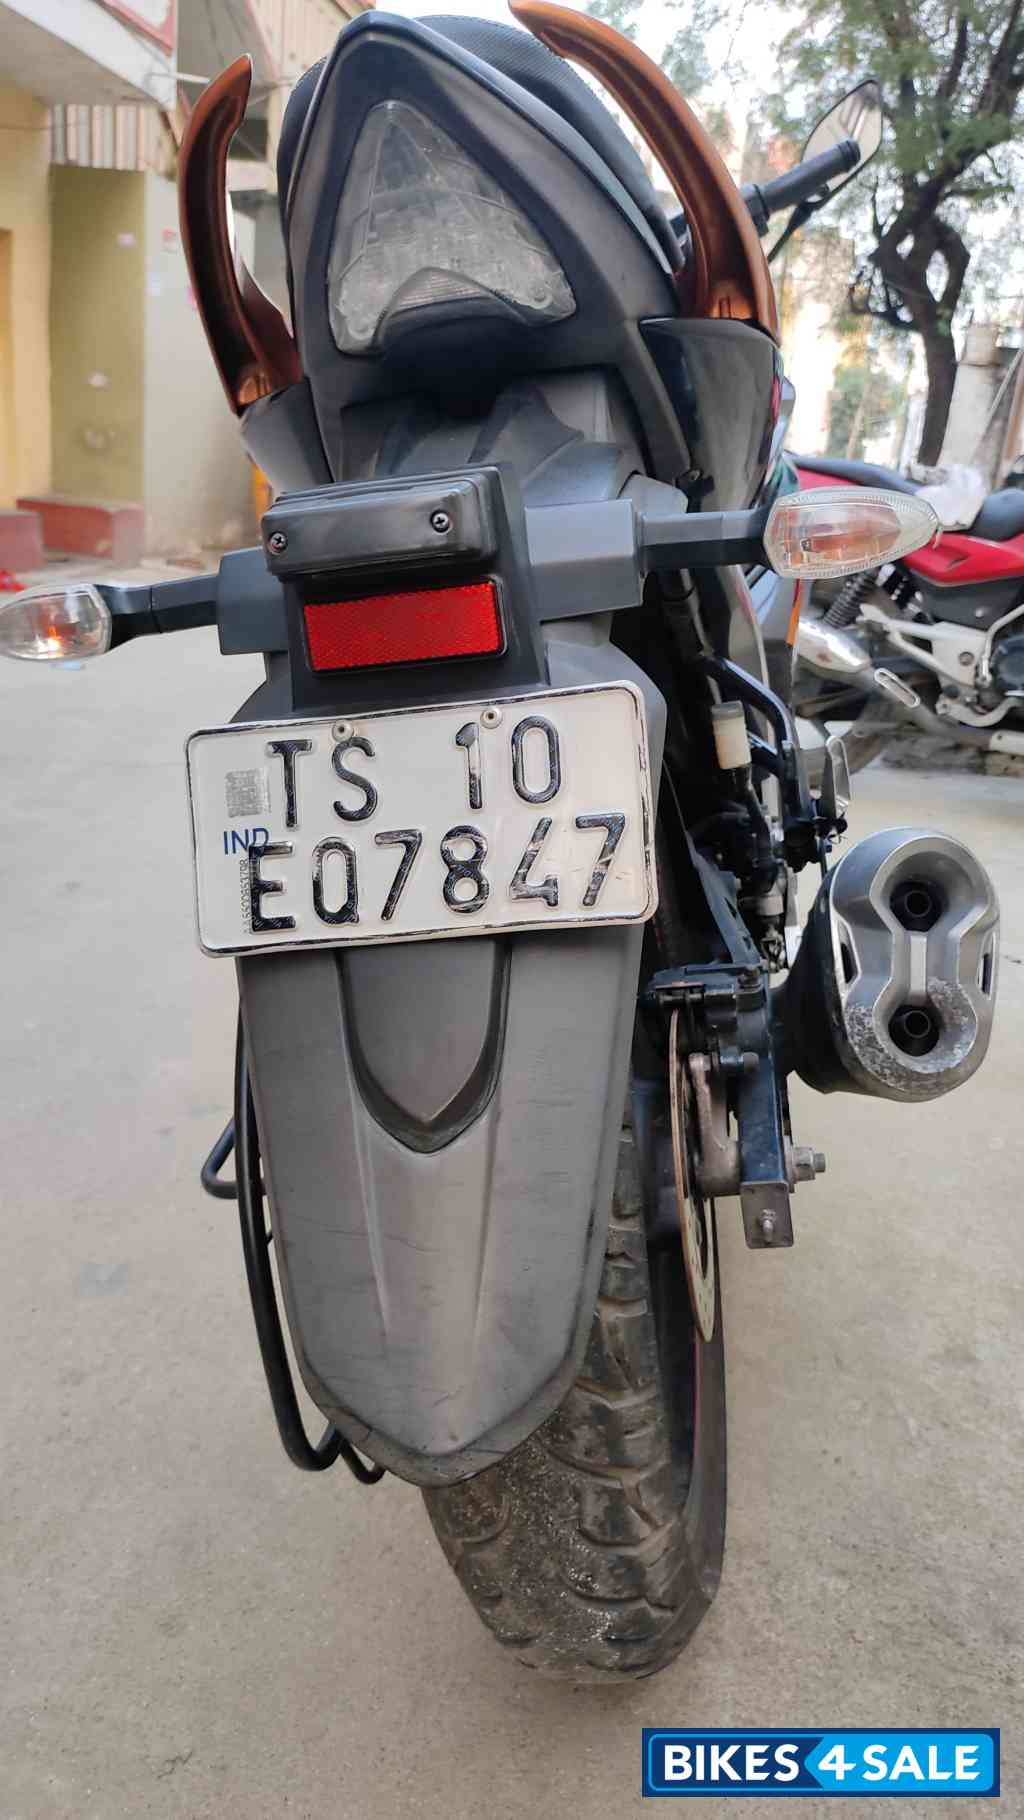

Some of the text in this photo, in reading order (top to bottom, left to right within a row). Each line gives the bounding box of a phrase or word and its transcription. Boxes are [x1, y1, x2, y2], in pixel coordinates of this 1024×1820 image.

[267, 715, 562, 829] TS 10
[223, 827, 269, 855] IND
